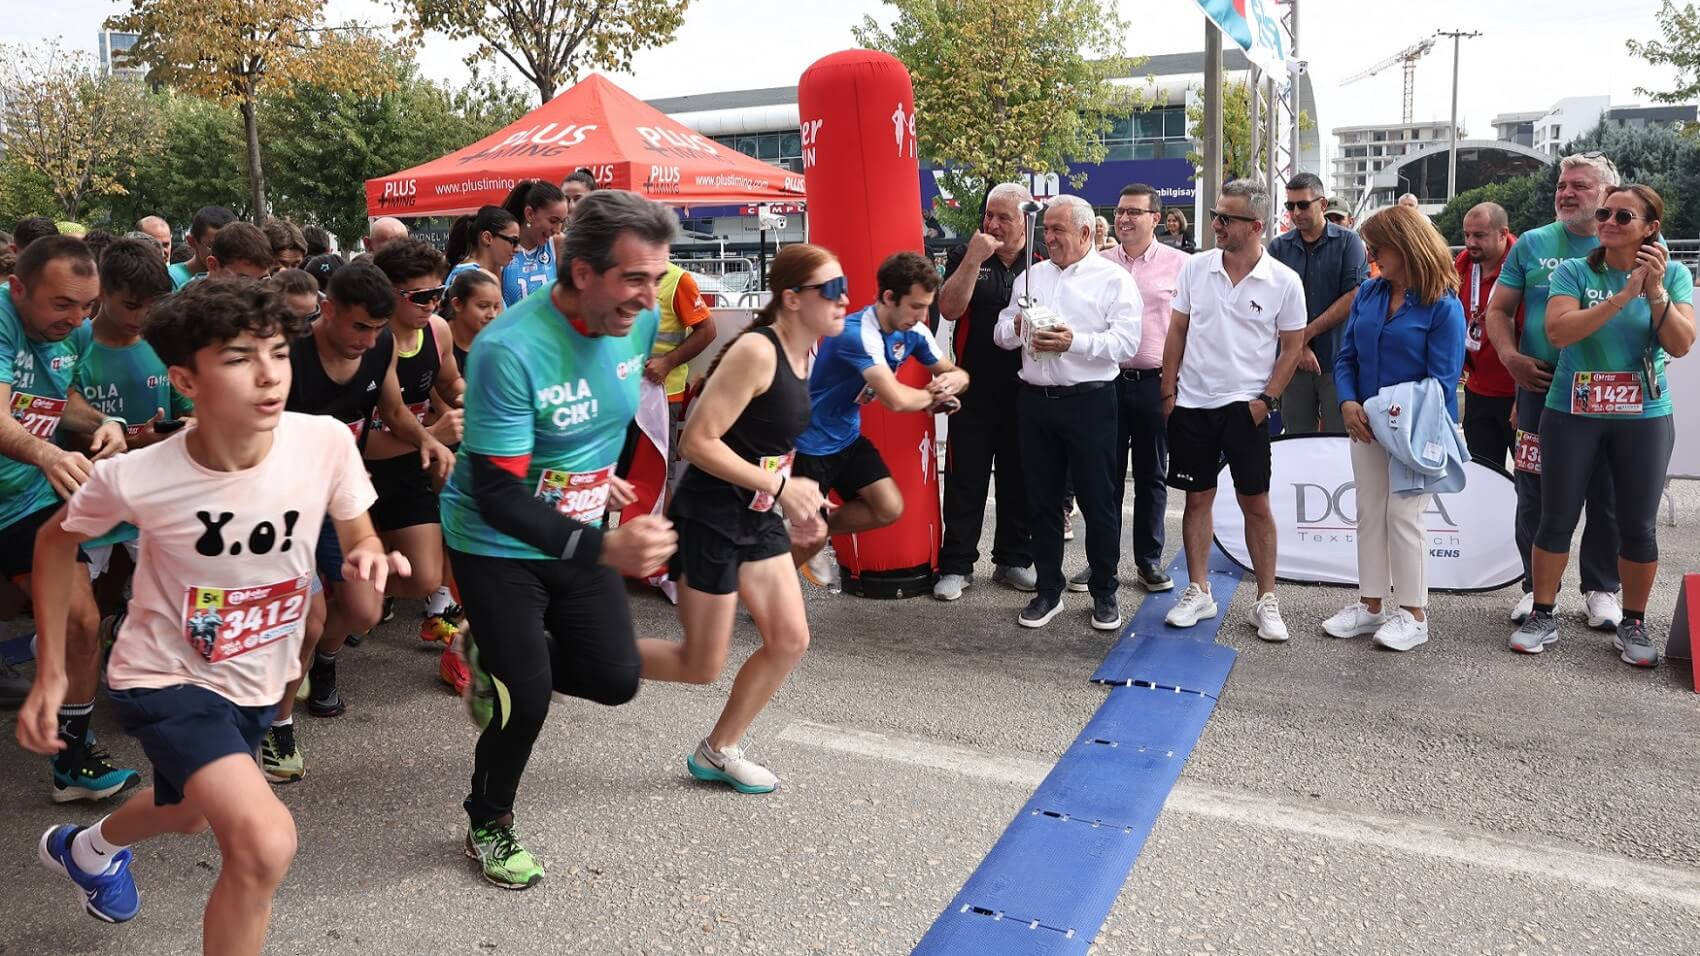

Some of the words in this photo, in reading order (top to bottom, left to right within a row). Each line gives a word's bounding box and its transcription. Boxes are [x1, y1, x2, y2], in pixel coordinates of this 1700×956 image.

[488, 122, 599, 154] PLUS
[635, 125, 720, 155] PLUS
[651, 165, 681, 183] PLUS
[695, 174, 769, 191] www.plustiming.com
[384, 179, 417, 198] PLUS
[1156, 188, 1197, 198] nbilgisay
[84, 383, 119, 400] OLA
[536, 378, 593, 409] YOLA
[1592, 385, 1640, 403] 1427
[1429, 548, 1461, 559] KENS
[223, 594, 305, 640] 3412
